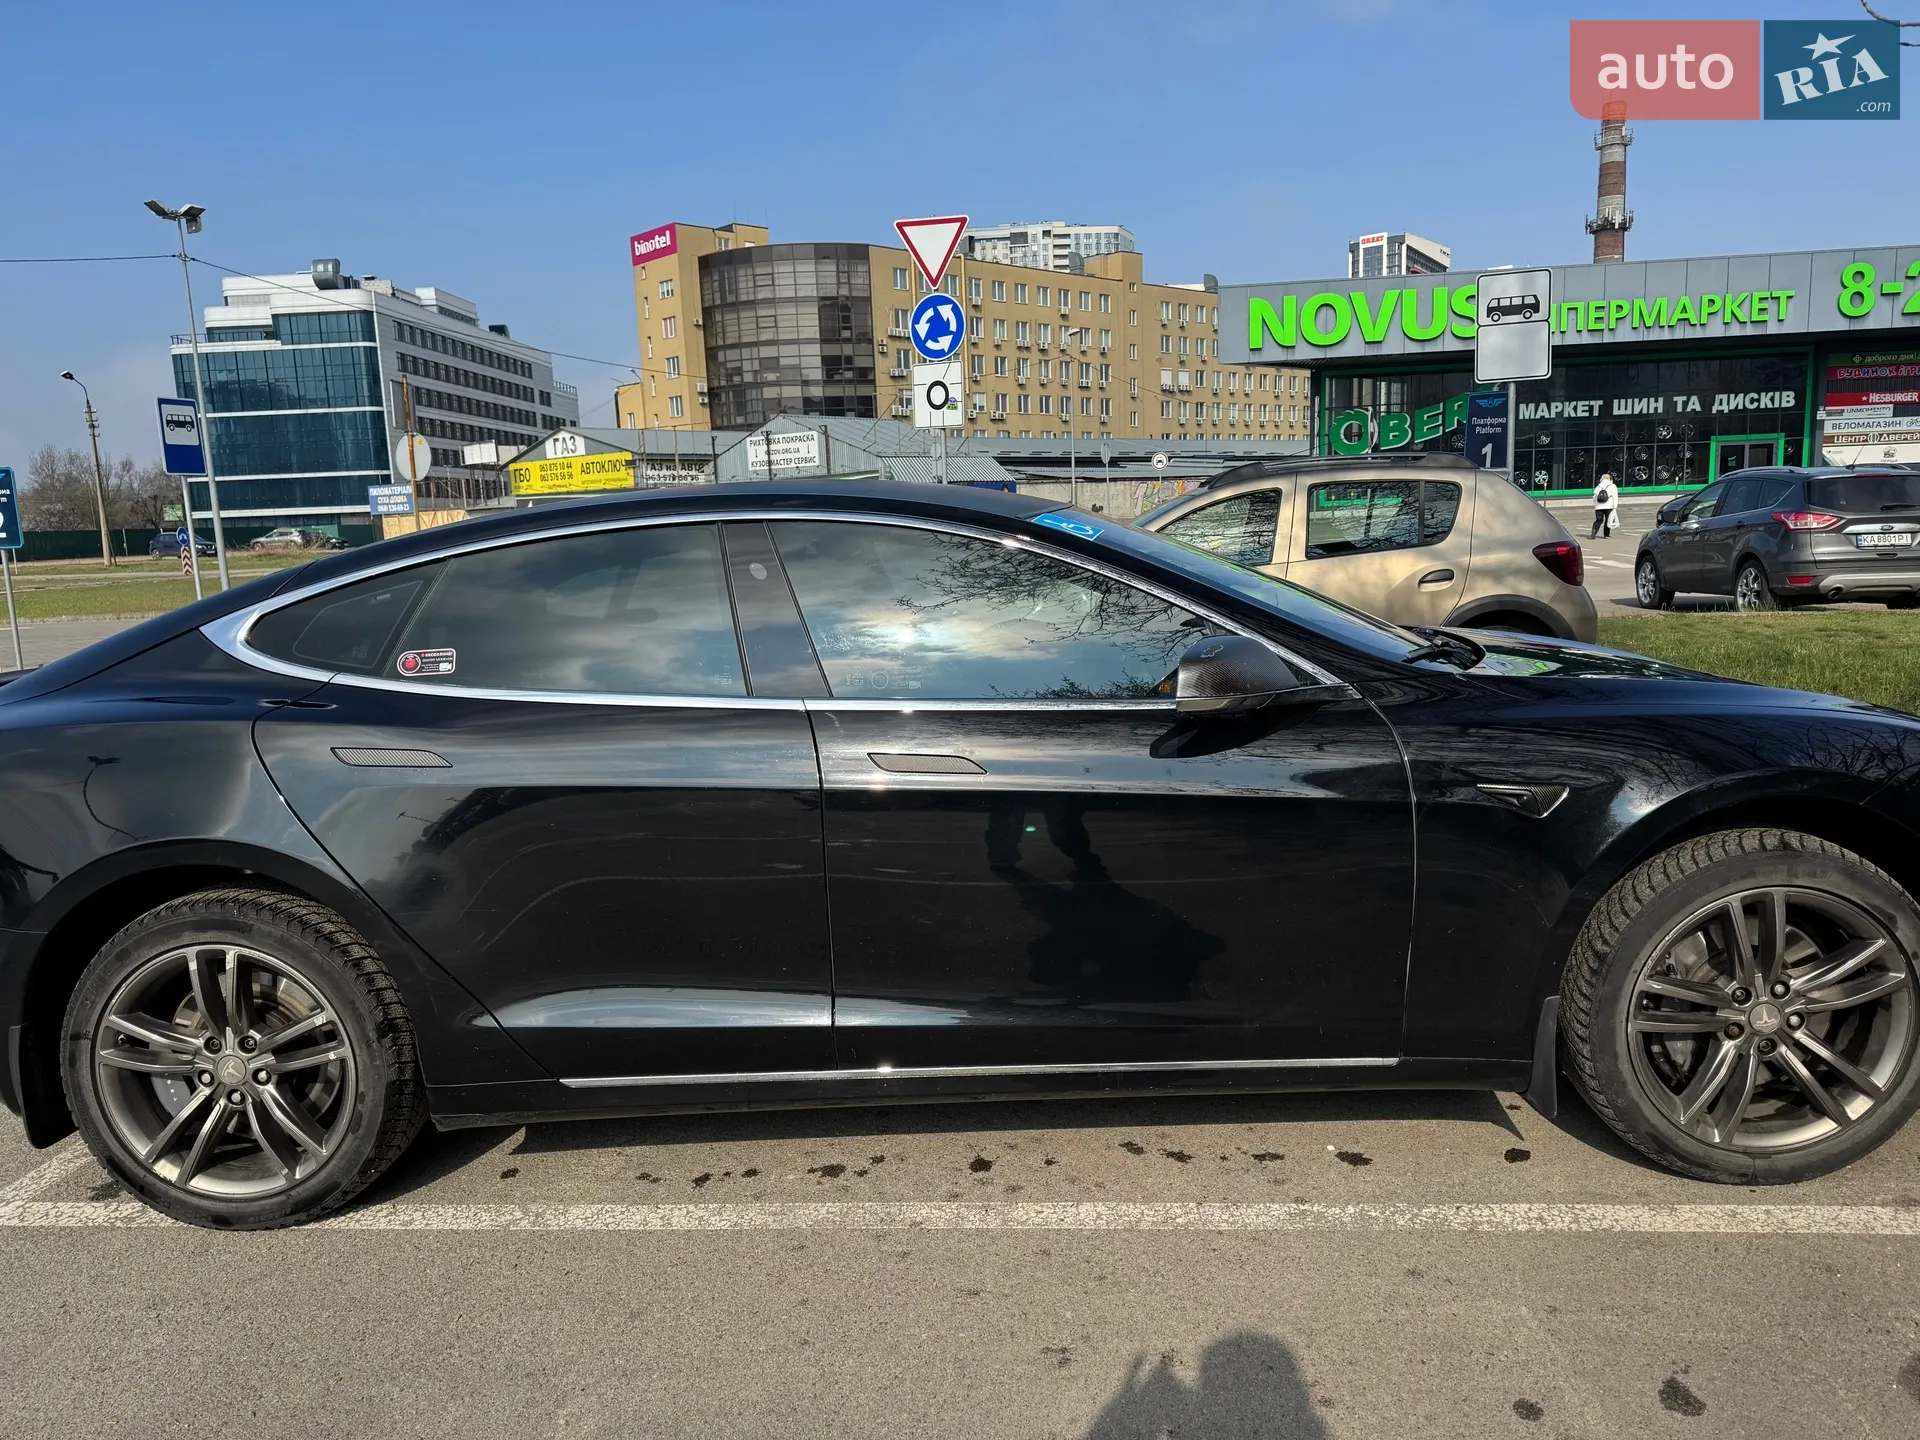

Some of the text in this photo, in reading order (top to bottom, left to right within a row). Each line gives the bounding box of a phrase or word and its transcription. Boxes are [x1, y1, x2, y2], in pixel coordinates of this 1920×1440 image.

[634, 230, 671, 256] binotel
[1249, 284, 1476, 350] NOVUS
[1552, 290, 1795, 333] ІПЕРМАРКЕТ
[1865, 354, 1898, 362] доброго
[1837, 366, 1896, 378] БУДИНОК
[1869, 392, 1919, 403] HESBURGER
[1518, 391, 1796, 419] МАРКЕТ ШИН ТА ДИСКІВ
[1472, 417, 1507, 425] Платформа
[1831, 420, 1902, 430] ВЕЛОМАГАЗИН
[1475, 426, 1502, 434] Platform
[781, 434, 815, 444] ПОКРАСКА
[553, 435, 577, 455] ГАЗ
[765, 447, 801, 456] KZOV.ORG.UA
[1481, 443, 1493, 468] 1
[539, 461, 572, 473] 063 875 10 44
[770, 458, 792, 467] МАСТЕР
[794, 456, 816, 464] СЕРВИС
[513, 467, 531, 483] ГБО
[540, 471, 573, 482] 063 576 56 56
